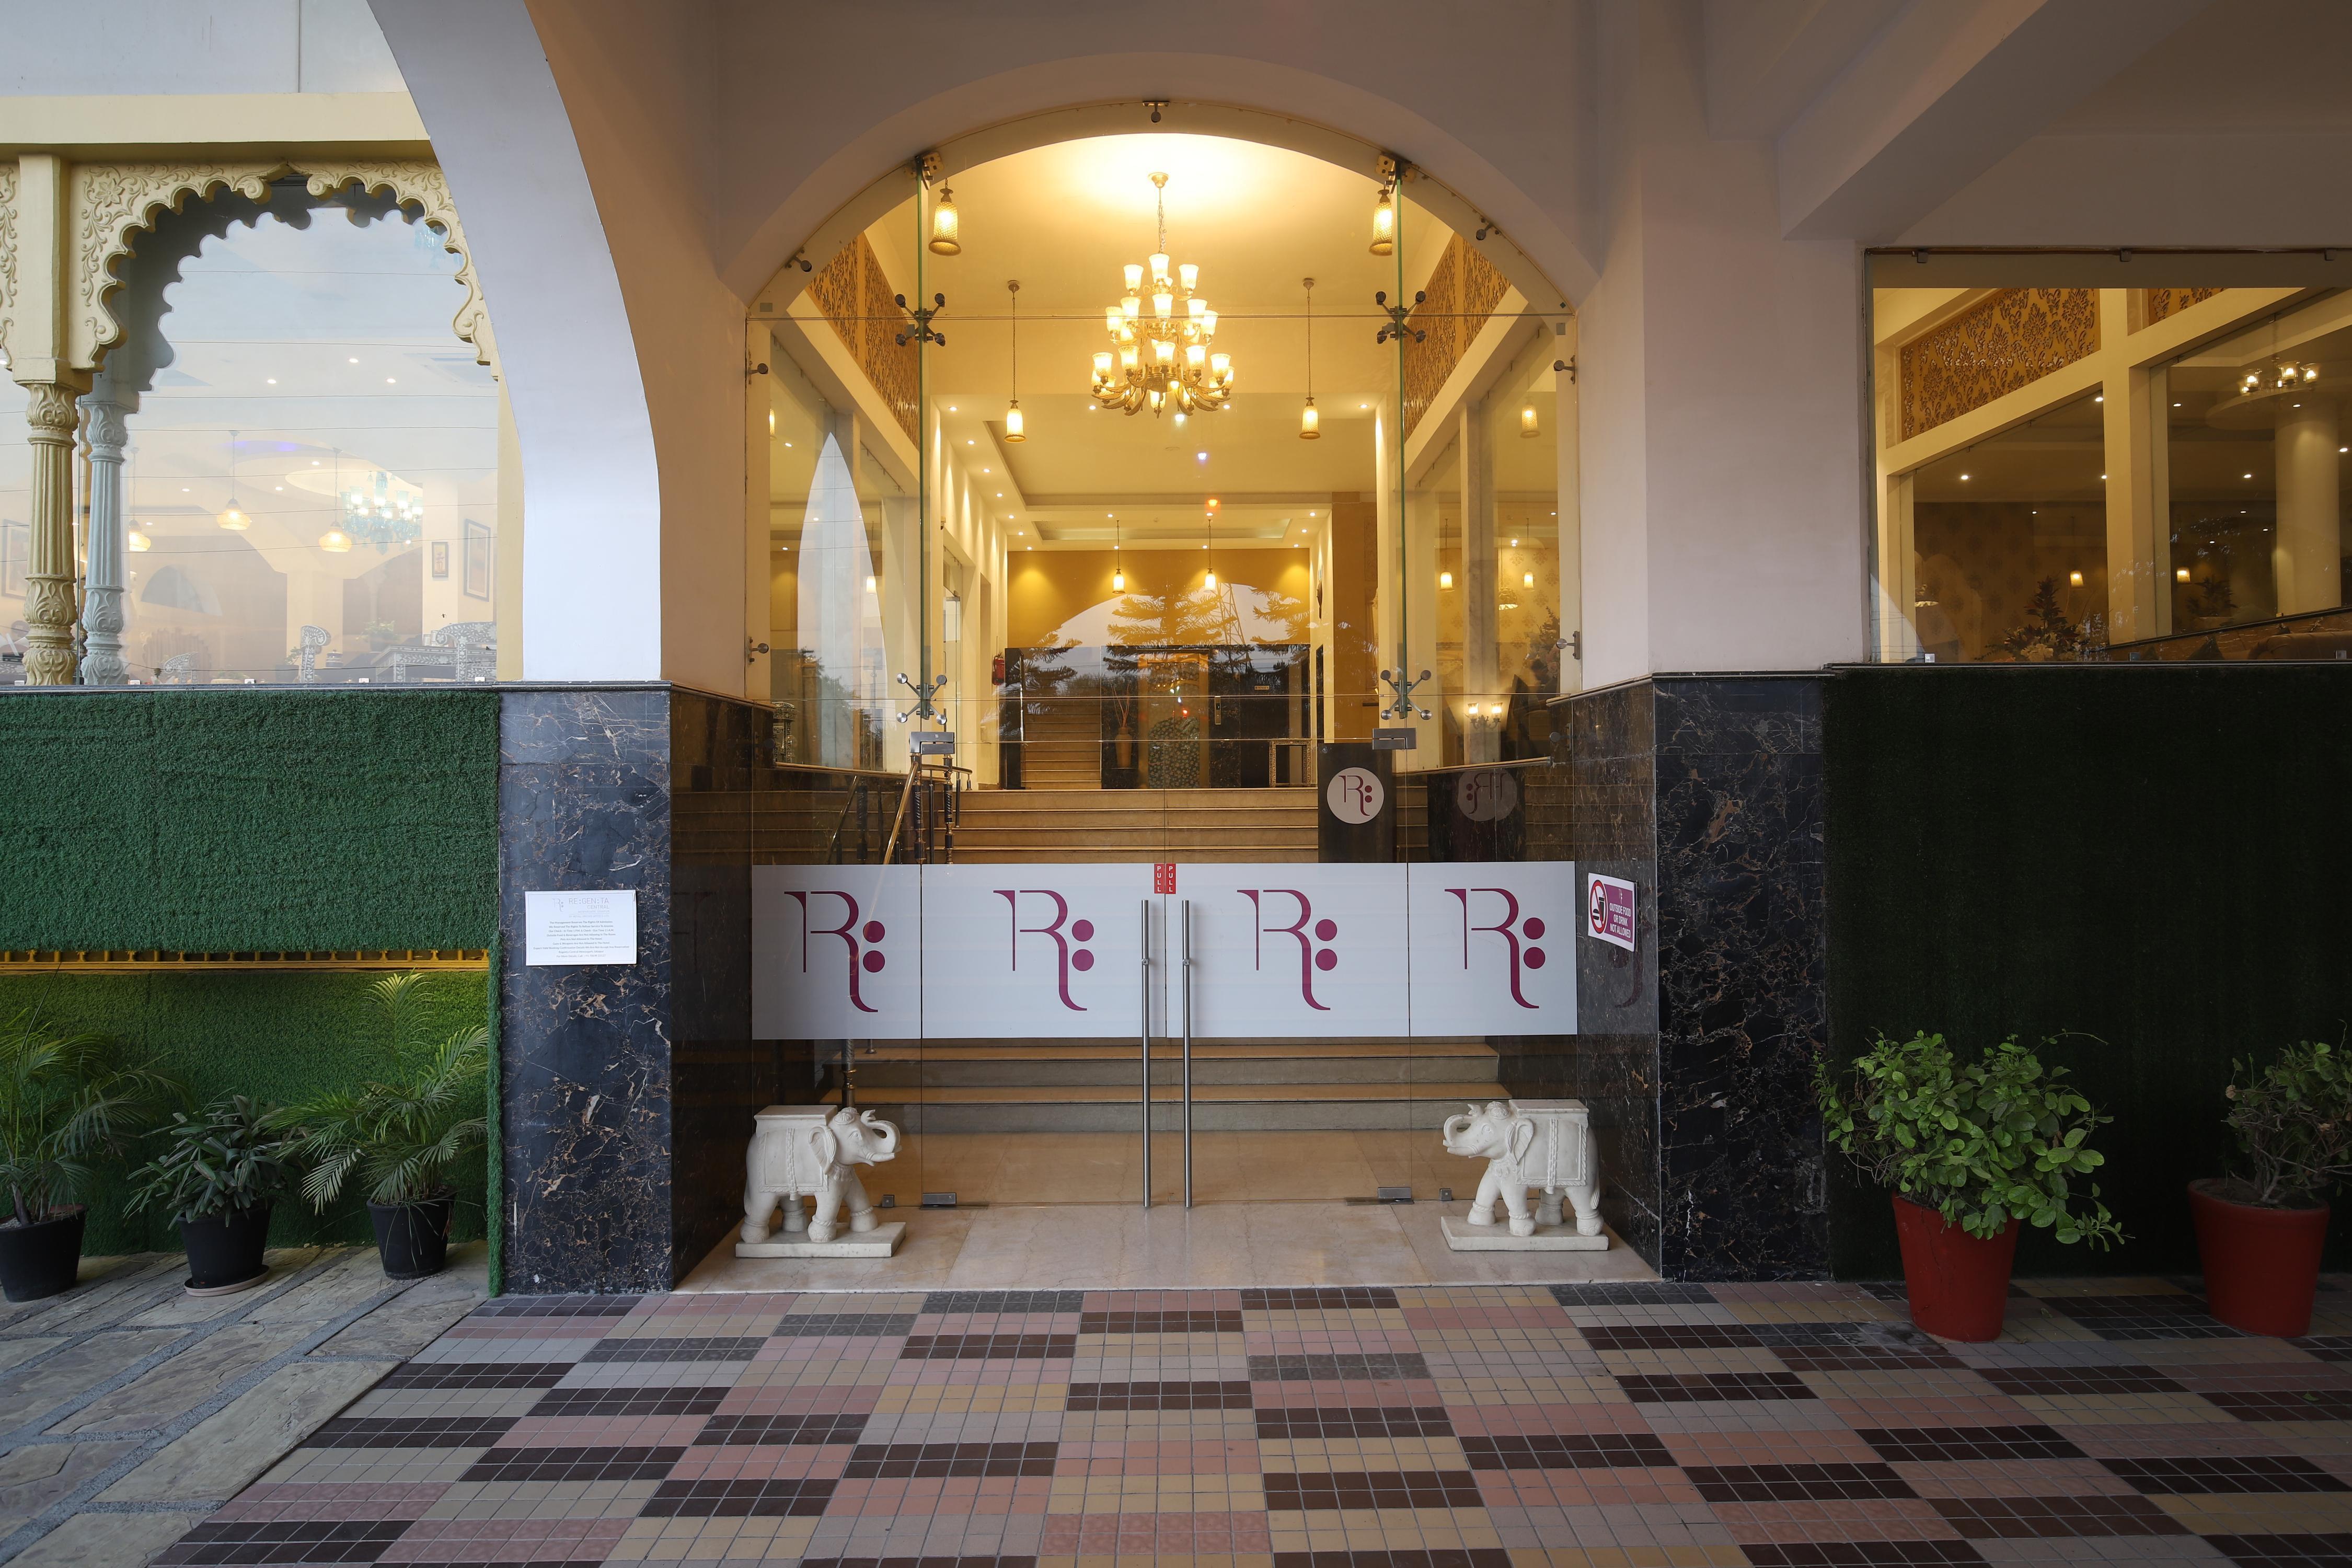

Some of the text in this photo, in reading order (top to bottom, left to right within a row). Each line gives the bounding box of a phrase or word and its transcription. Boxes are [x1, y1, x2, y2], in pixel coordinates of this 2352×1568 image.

[1609, 903, 1631, 917] OUTSIDE FOOD
[1613, 914, 1628, 927] OR DRINK
[1617, 925, 1631, 938] ALLOWED
